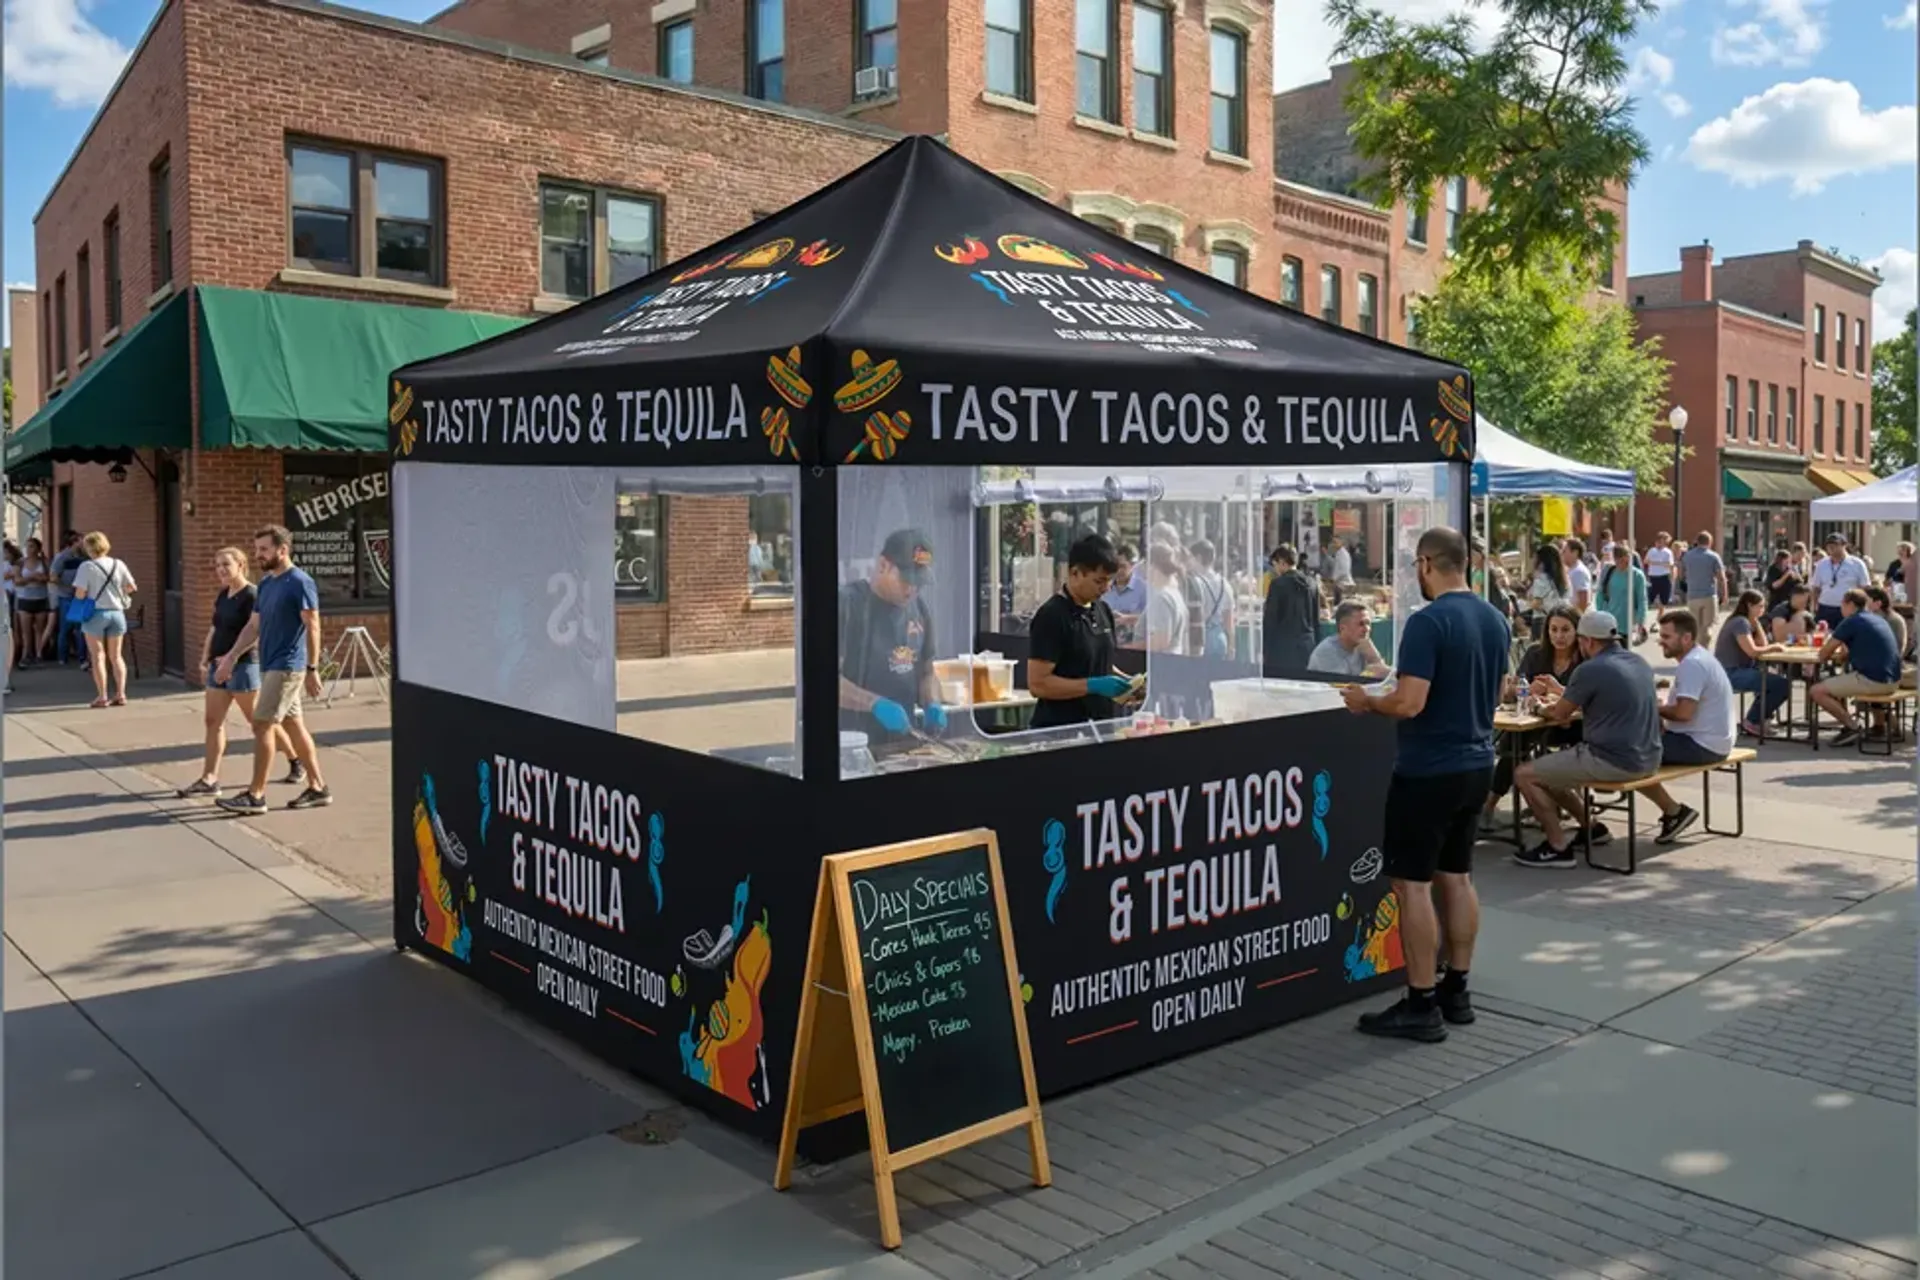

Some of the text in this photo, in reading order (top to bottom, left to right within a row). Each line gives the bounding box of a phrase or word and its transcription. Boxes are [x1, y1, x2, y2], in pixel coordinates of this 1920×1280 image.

[980, 270, 1173, 304] TASTY TACOS
[1039, 300, 1204, 331] & TEQUILA
[423, 383, 748, 449] TASTY TACOS & TEQUILA
[921, 383, 1419, 451] TASTY TACOS & TEQUILA
[494, 754, 641, 863] TASTY TACOS
[1077, 766, 1303, 870] TASTY TACOS
[512, 832, 625, 933] & TEQUILA
[1110, 844, 1281, 944] & TEQUILA
[484, 898, 666, 1007] AUTHENTIC MEXICAN STREET FOOD
[915, 961, 927, 982] &
[1051, 913, 1331, 1018] AUTHENTIC MEXICAN STREET FOOD
[536, 962, 599, 1018] OPEN DAILY
[1152, 976, 1247, 1032] OPEN DAILY
